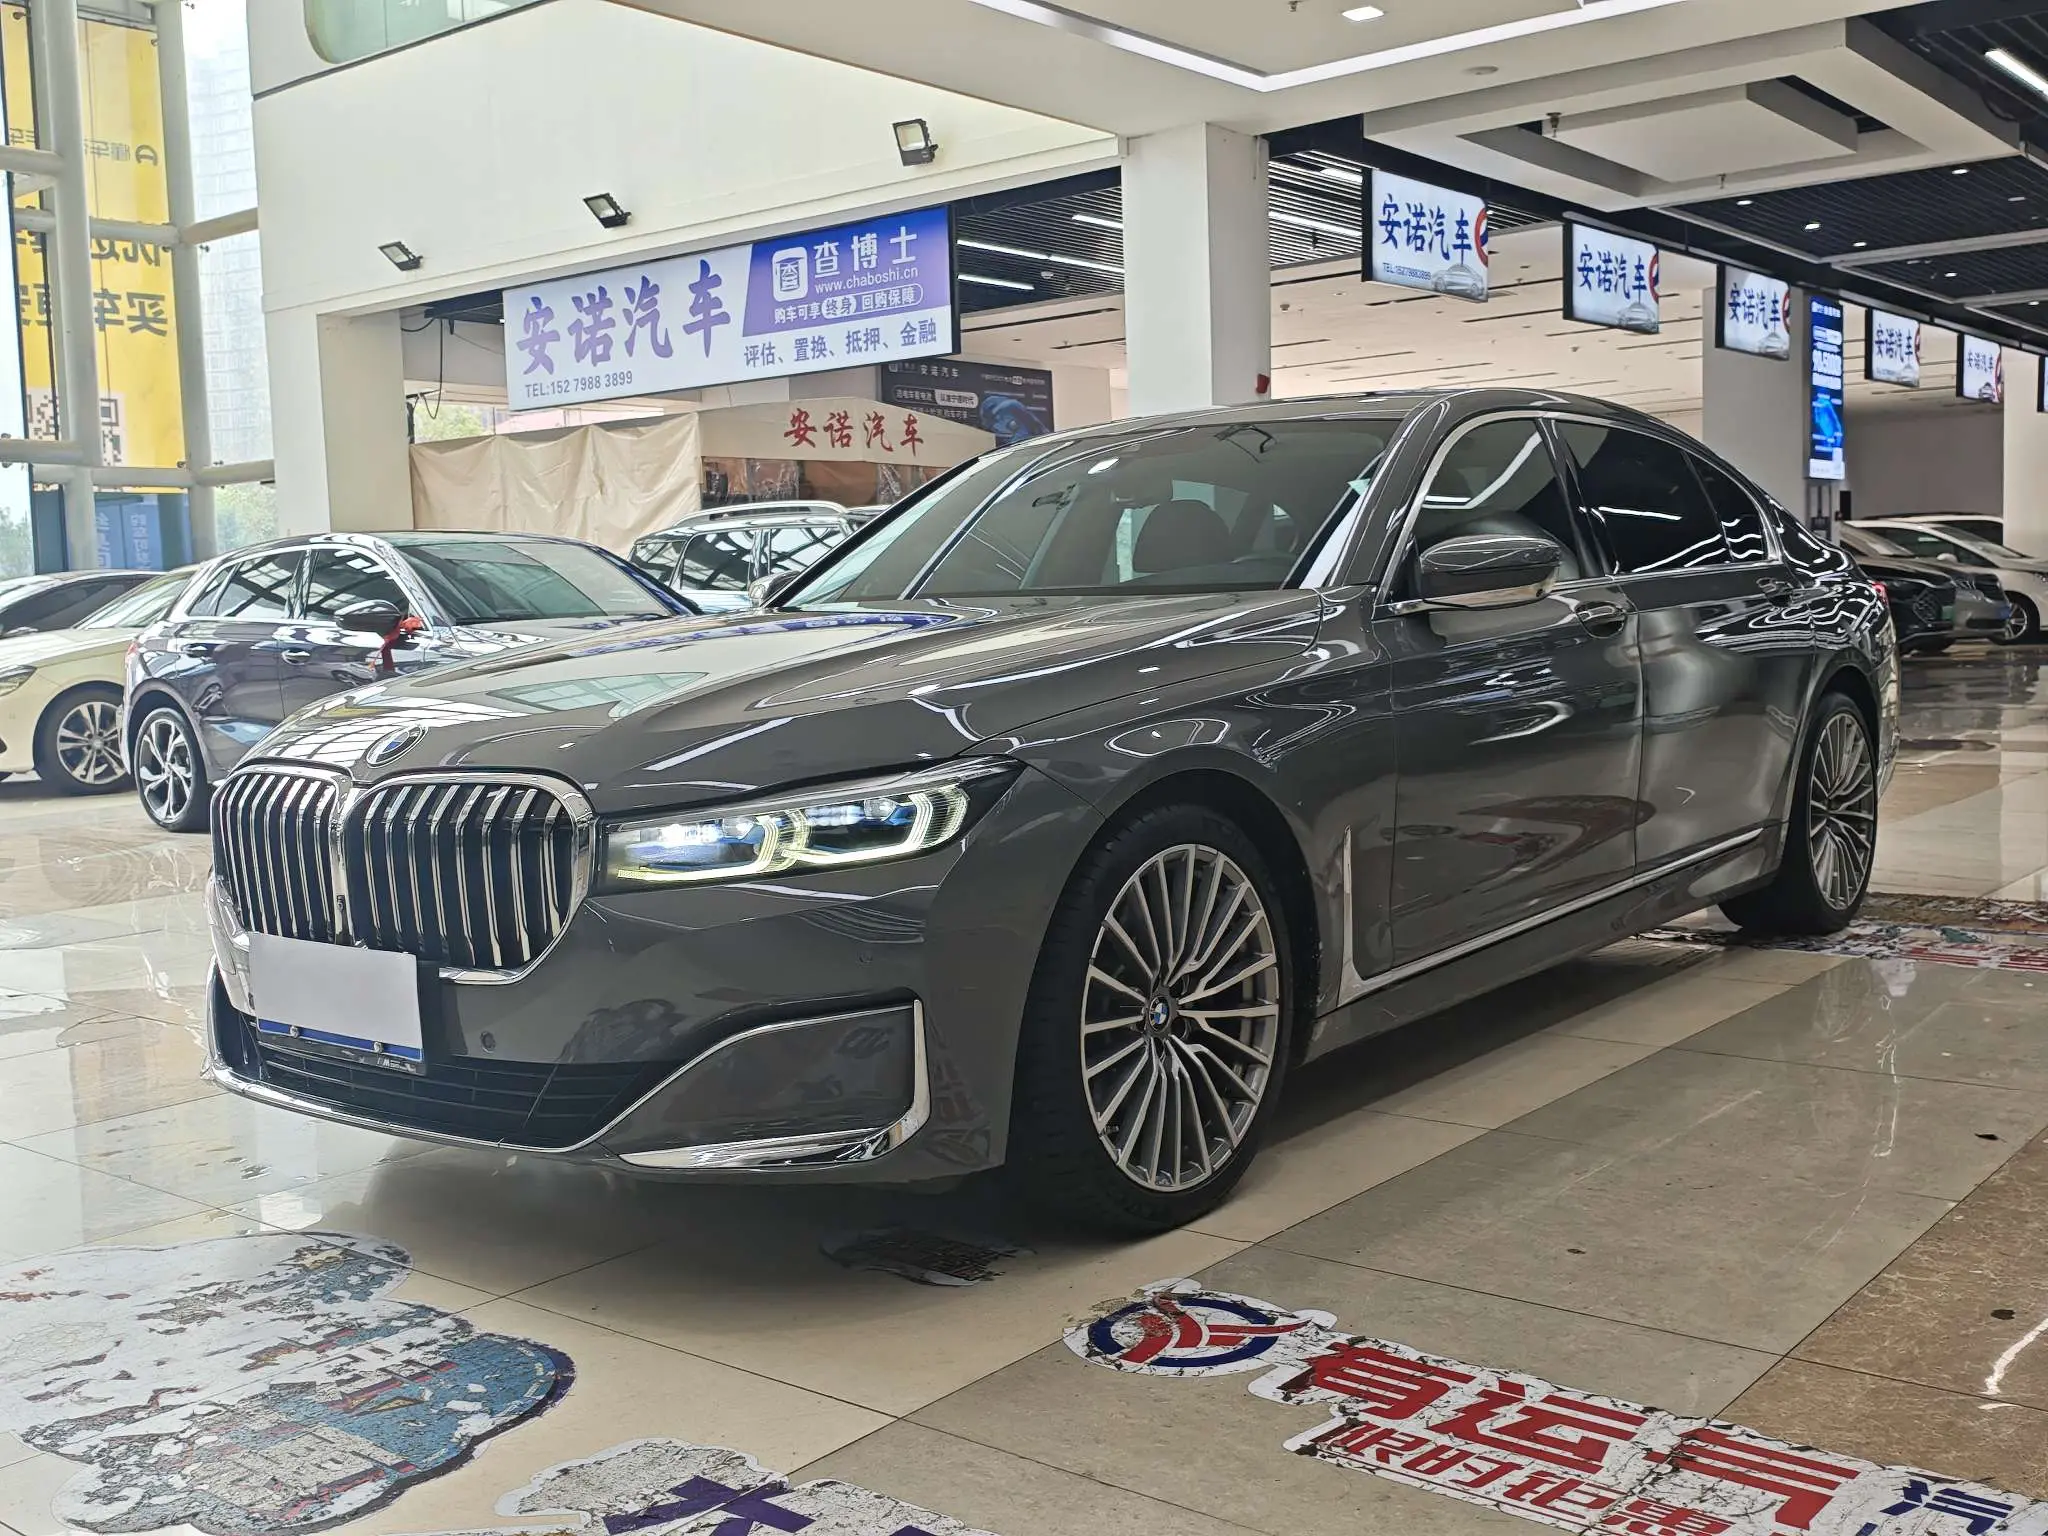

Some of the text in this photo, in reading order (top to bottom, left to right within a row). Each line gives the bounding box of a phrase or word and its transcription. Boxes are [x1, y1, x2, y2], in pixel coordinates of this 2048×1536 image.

[813, 225, 918, 279] 查博士
[1378, 193, 1473, 266] 安诺汽车
[814, 266, 919, 295] www.chaboshi.cn
[1577, 243, 1648, 303] 安诺汽车
[516, 258, 731, 375] 安诺汽车
[1728, 282, 1781, 333] 安诺汽车
[525, 370, 633, 399] TEL:152 7988 3899
[783, 407, 924, 457] 安诺汽车
